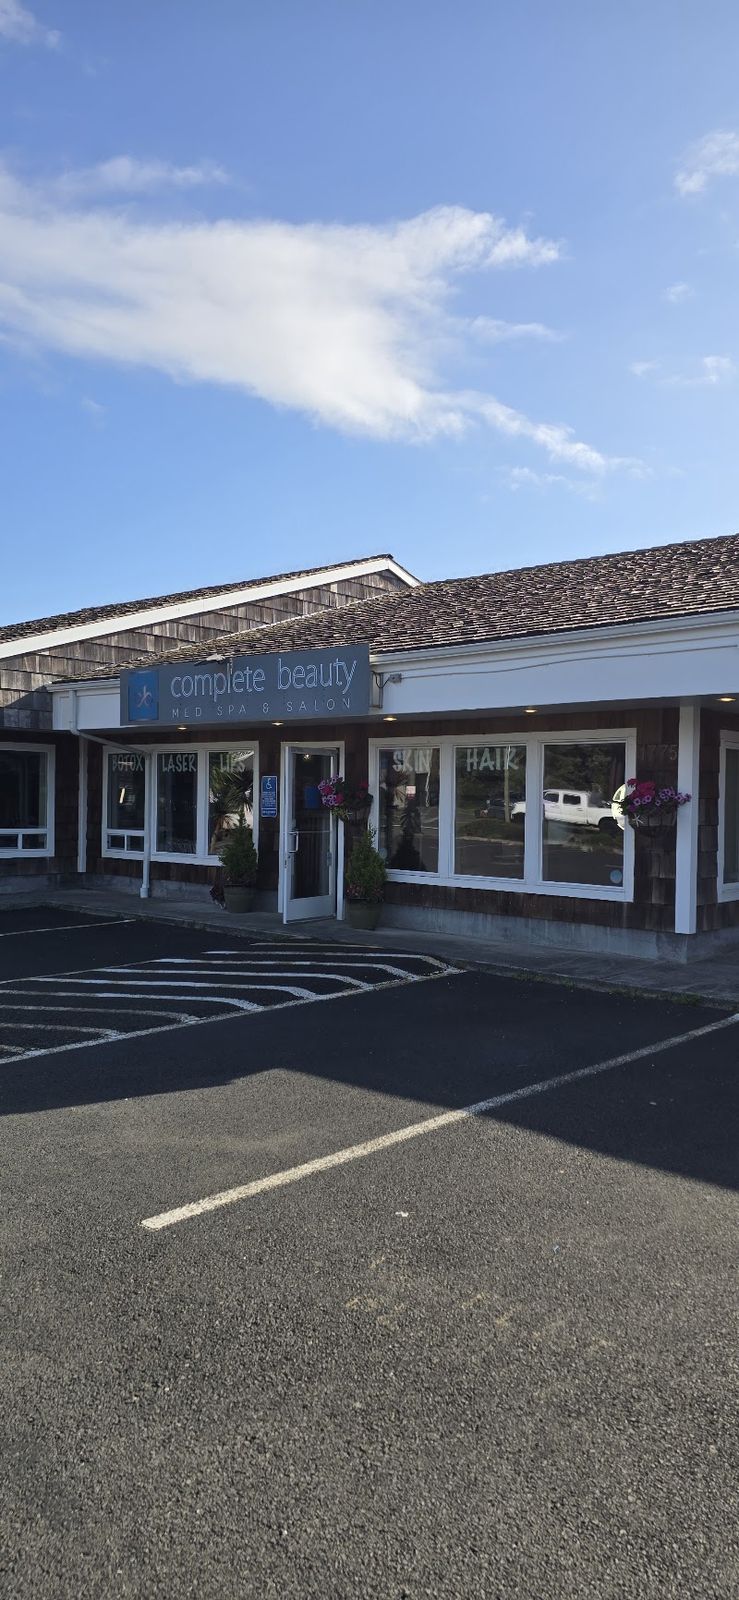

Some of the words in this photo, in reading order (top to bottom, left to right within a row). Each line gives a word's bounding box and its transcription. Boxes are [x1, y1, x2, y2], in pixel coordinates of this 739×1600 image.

[170, 660, 266, 702] complete
[277, 658, 357, 694] beauty
[172, 706, 202, 718] MED
[217, 703, 247, 716] SPA
[262, 702, 269, 713] &
[286, 698, 351, 712] SALON
[112, 754, 144, 772] BOTOX
[161, 753, 197, 772] LASER
[392, 748, 432, 772] SKIN
[466, 747, 519, 772] HAIR
